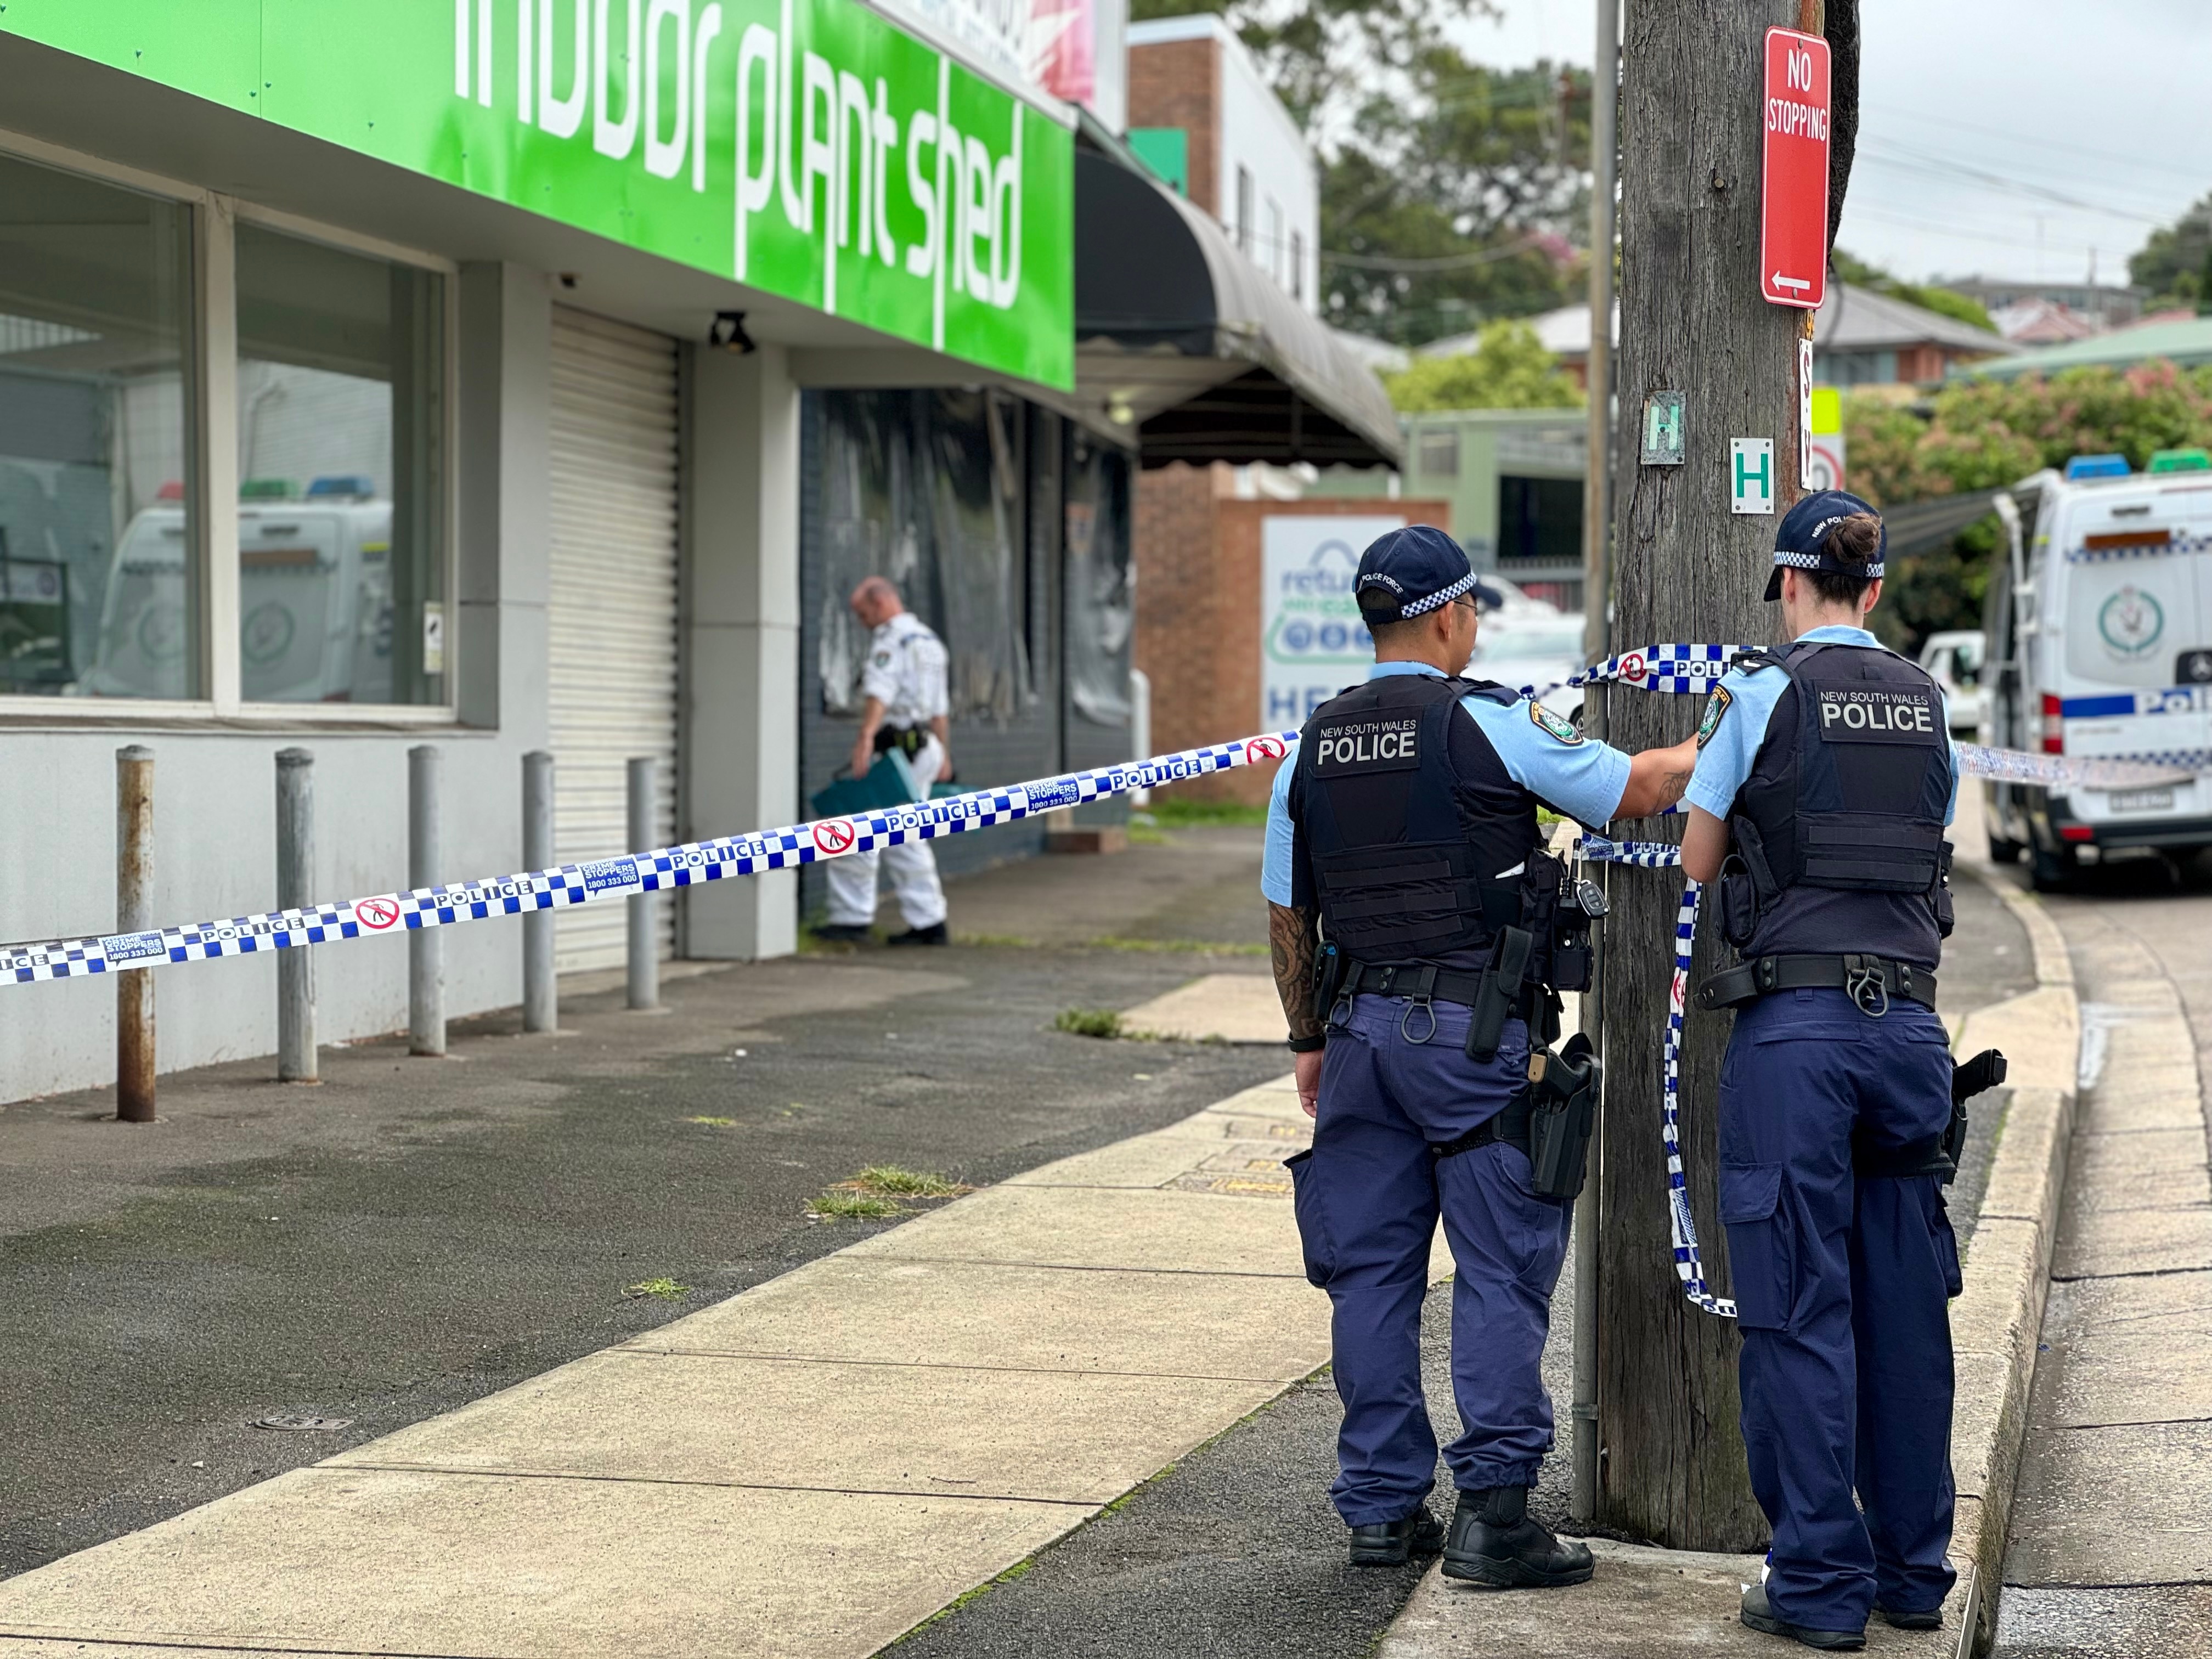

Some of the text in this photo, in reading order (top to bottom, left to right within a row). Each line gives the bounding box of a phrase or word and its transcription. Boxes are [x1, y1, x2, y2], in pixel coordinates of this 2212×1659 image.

[1787, 49, 1812, 92] NO
[1768, 98, 1827, 142] STOPPING
[907, 53, 1023, 352] shed
[1648, 405, 1679, 450] H
[1736, 453, 1769, 498] H
[1812, 521, 1826, 538] NSW
[1362, 572, 1404, 594] POLICE FORCE
[1820, 691, 1928, 706] NEW SOUTH WALES
[1320, 719, 1417, 738] NEW SOUTH WALES
[1822, 703, 1933, 732] POLICE
[1318, 731, 1415, 765] POLICE
[1114, 760, 1199, 789] POLICE
[1026, 781, 1059, 792] CRIME
[1029, 783, 1077, 800] STOPPERS
[889, 802, 977, 830] POLICE
[673, 841, 763, 868] POLICE
[583, 861, 616, 872] CRIME
[585, 864, 635, 879] STOPPERS
[588, 874, 637, 889] 1800 333 000
[436, 881, 530, 906] POLICE
[205, 918, 301, 941] POLICE
[105, 936, 142, 946] CRIME
[107, 939, 161, 952] STOPPERS
[109, 952, 129, 960] 1800
